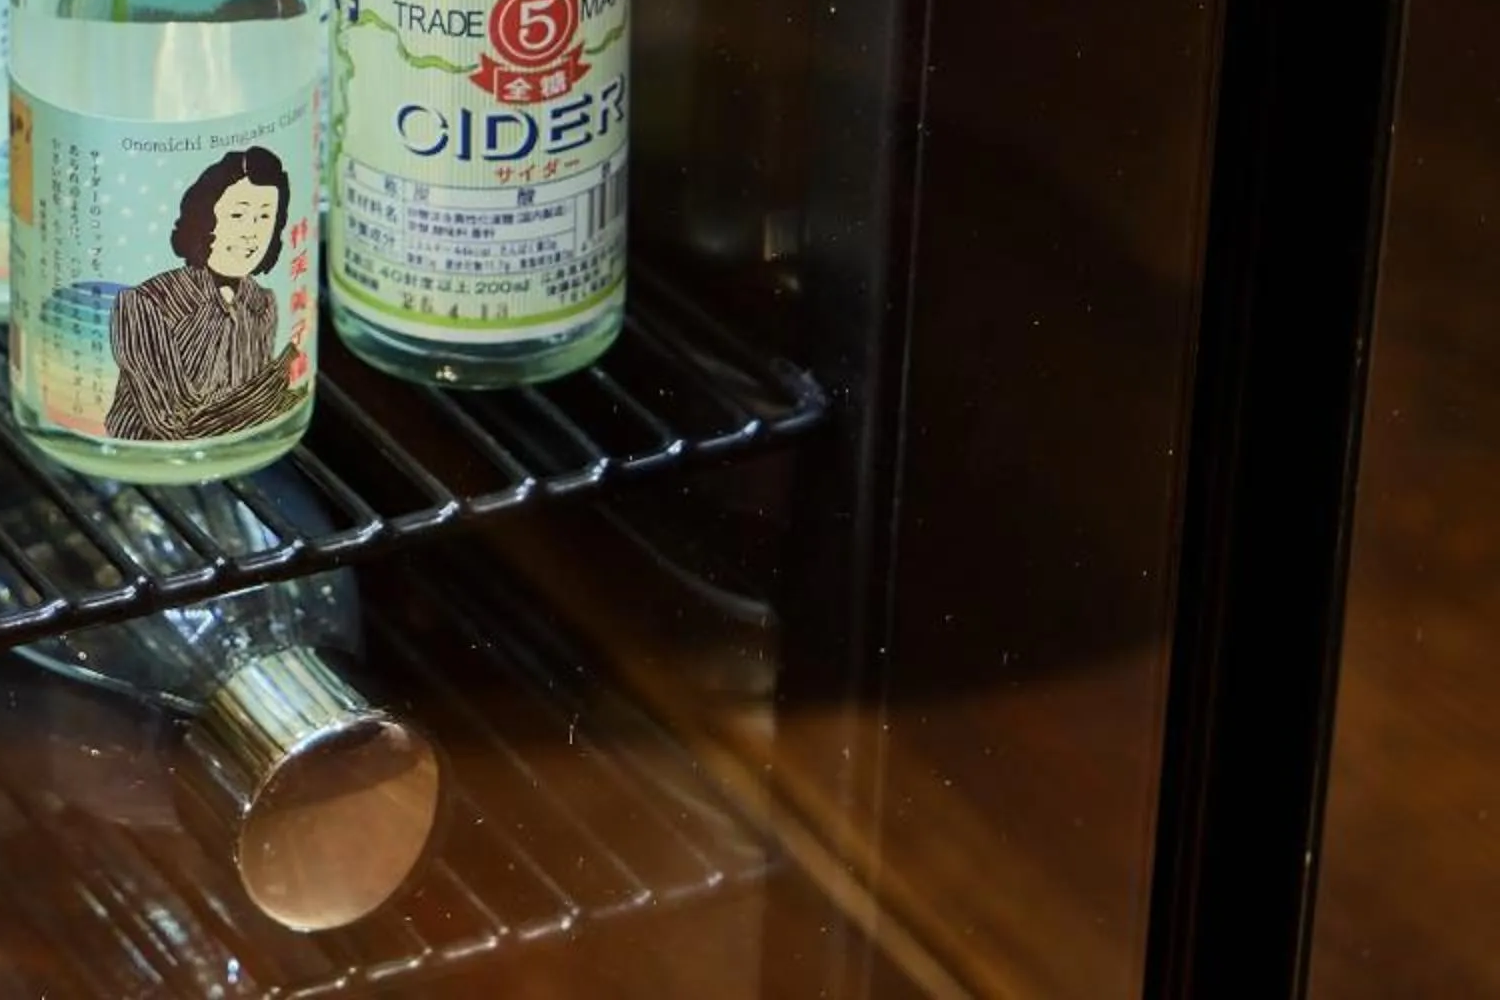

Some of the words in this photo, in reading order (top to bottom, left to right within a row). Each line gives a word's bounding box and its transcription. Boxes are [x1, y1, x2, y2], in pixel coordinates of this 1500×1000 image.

[392, 0, 485, 38] TRADE
[396, 75, 626, 161] CIDER
[120, 135, 202, 153] Onomichi
